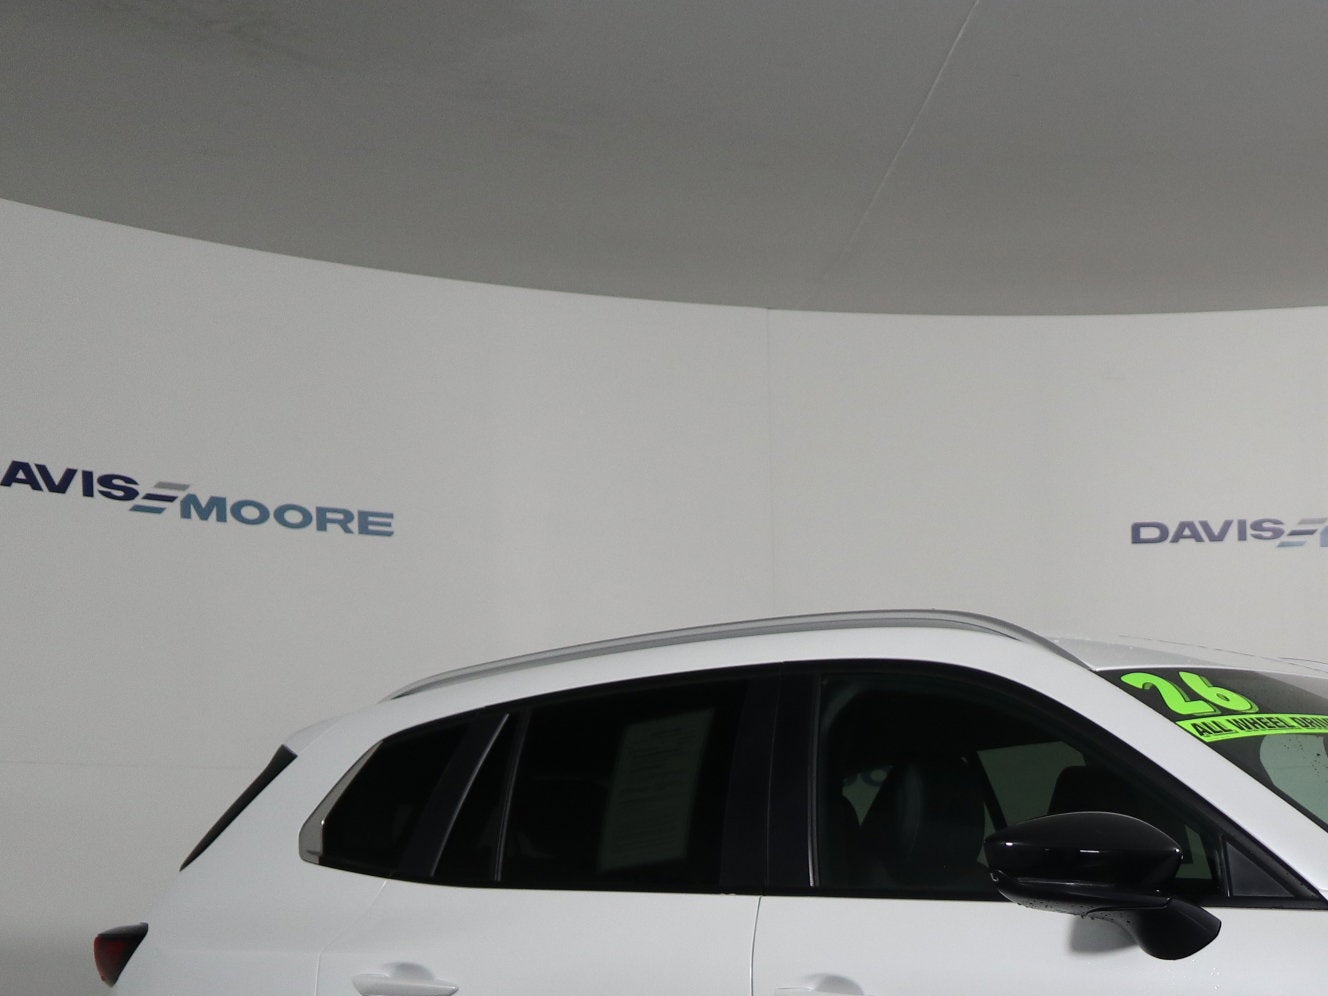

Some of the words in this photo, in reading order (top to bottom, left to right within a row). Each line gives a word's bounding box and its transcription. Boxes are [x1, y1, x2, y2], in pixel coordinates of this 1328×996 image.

[180, 493, 394, 537] MOORE
[1131, 517, 1285, 545] DAVIS
[1120, 671, 1259, 716] 26
[1191, 720, 1233, 737] ALL
[1225, 716, 1295, 731] WHEEL
